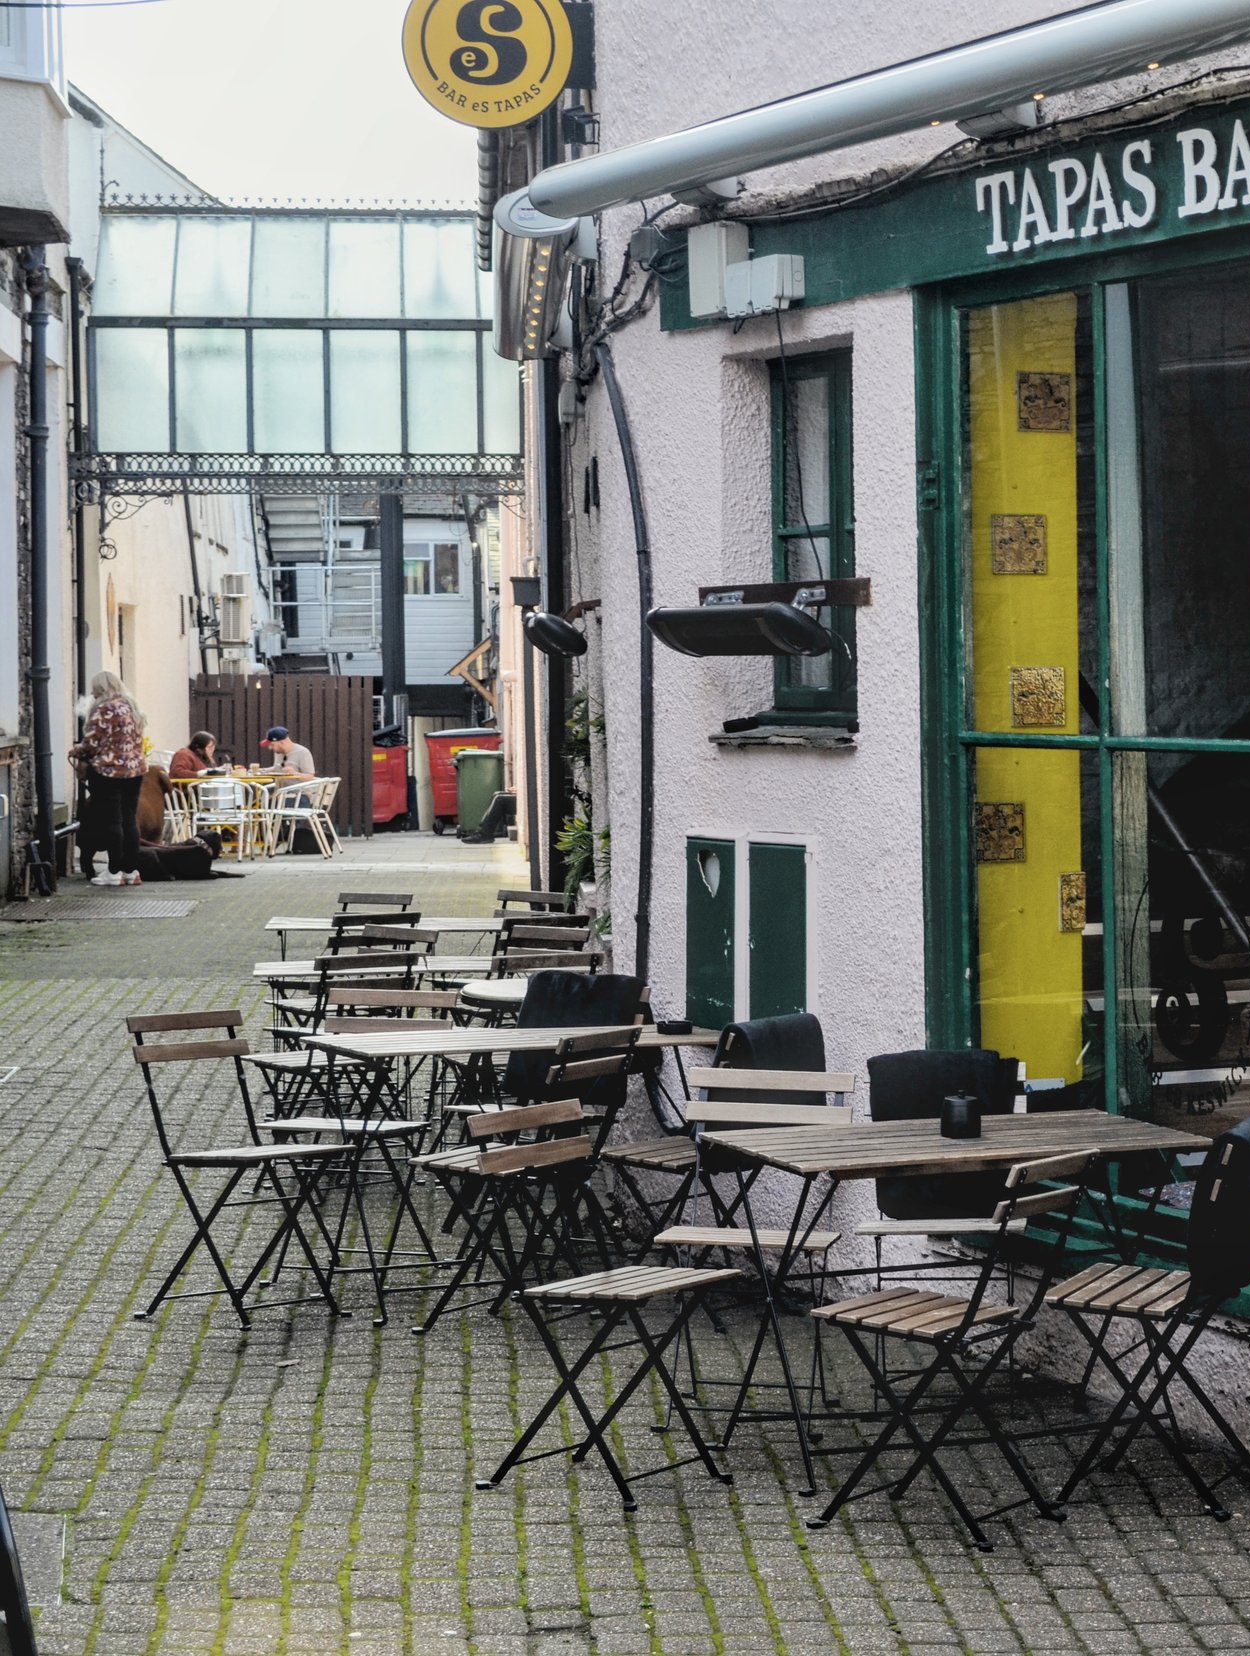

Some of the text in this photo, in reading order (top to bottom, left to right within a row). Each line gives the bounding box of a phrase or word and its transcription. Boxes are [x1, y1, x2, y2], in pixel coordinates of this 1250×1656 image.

[436, 81, 467, 107] BAR
[494, 83, 541, 113] TAPAS
[975, 140, 1156, 254] TAPAS
